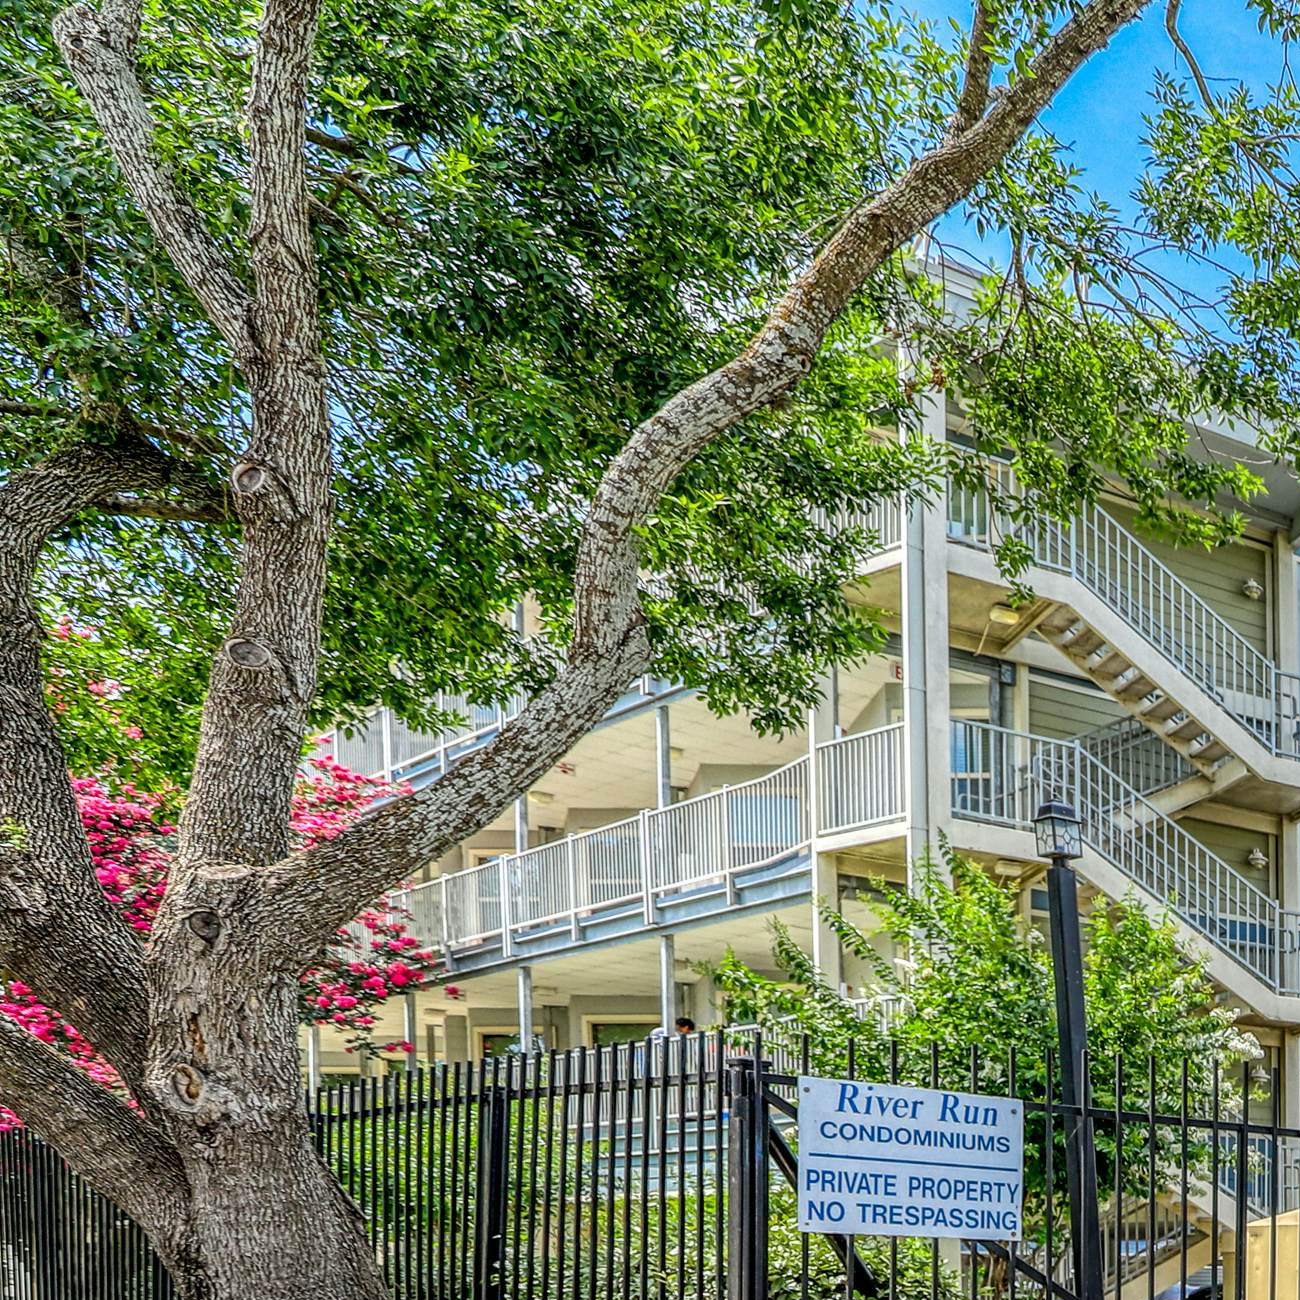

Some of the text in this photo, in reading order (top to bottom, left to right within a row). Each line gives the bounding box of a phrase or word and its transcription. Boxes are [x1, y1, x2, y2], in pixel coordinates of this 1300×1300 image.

[835, 1082, 998, 1127] River Run
[820, 1120, 1010, 1153] CONDOMINIUMS
[806, 1169, 1019, 1204] PRIVATE PROPERTY
[807, 1200, 1018, 1231] NO TRESPASSING
